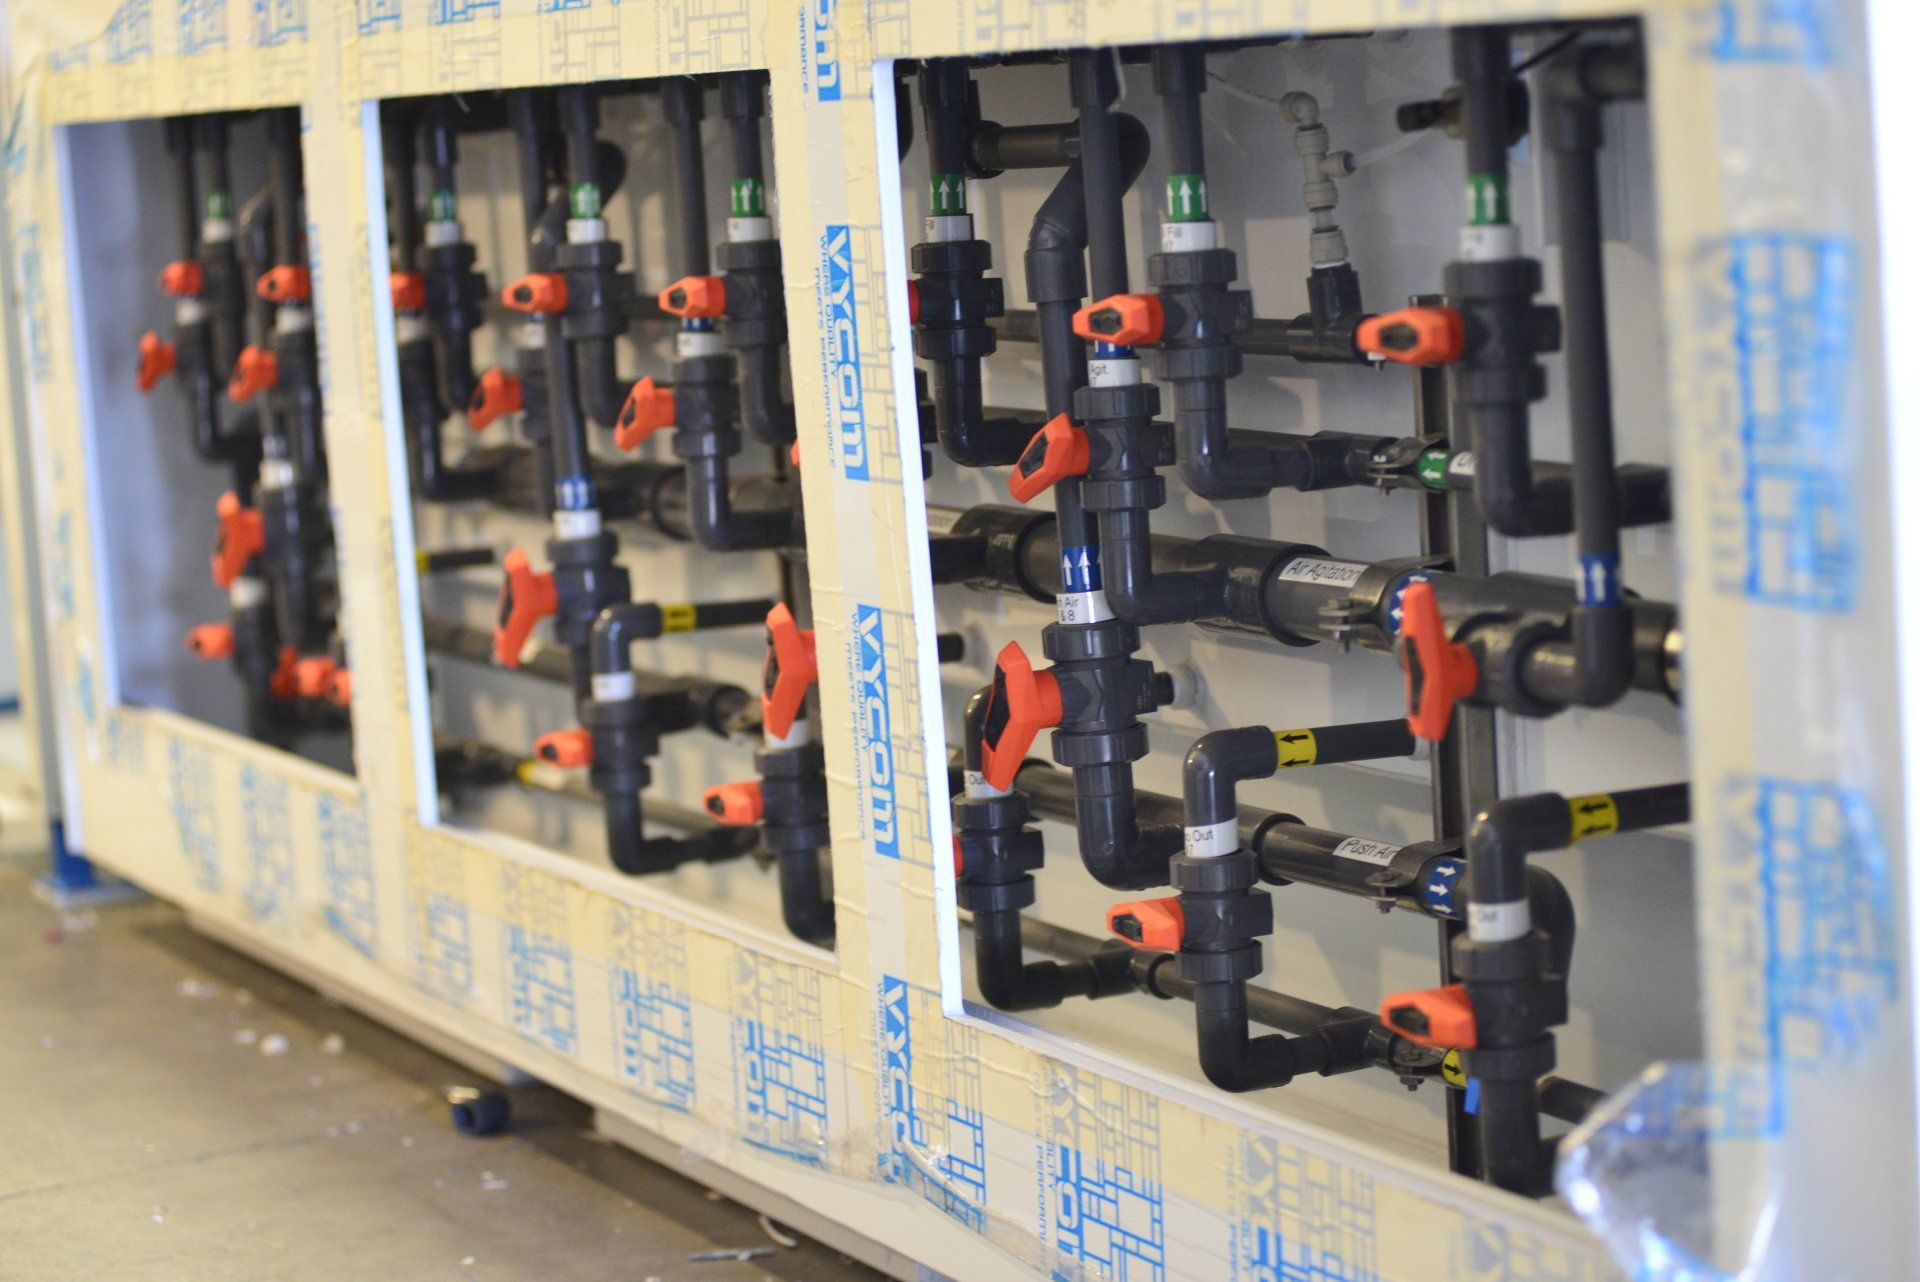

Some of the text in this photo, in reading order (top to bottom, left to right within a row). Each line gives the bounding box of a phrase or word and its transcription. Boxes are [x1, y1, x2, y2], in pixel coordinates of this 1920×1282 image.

[820, 234, 838, 378] WHERE QUALITY
[818, 336, 837, 471] PERFORMANCE
[850, 612, 868, 752] WHERE QUALITY
[850, 710, 867, 841] PERFORMANCE
[1192, 829, 1214, 842] Out
[1341, 839, 1377, 857] Push
